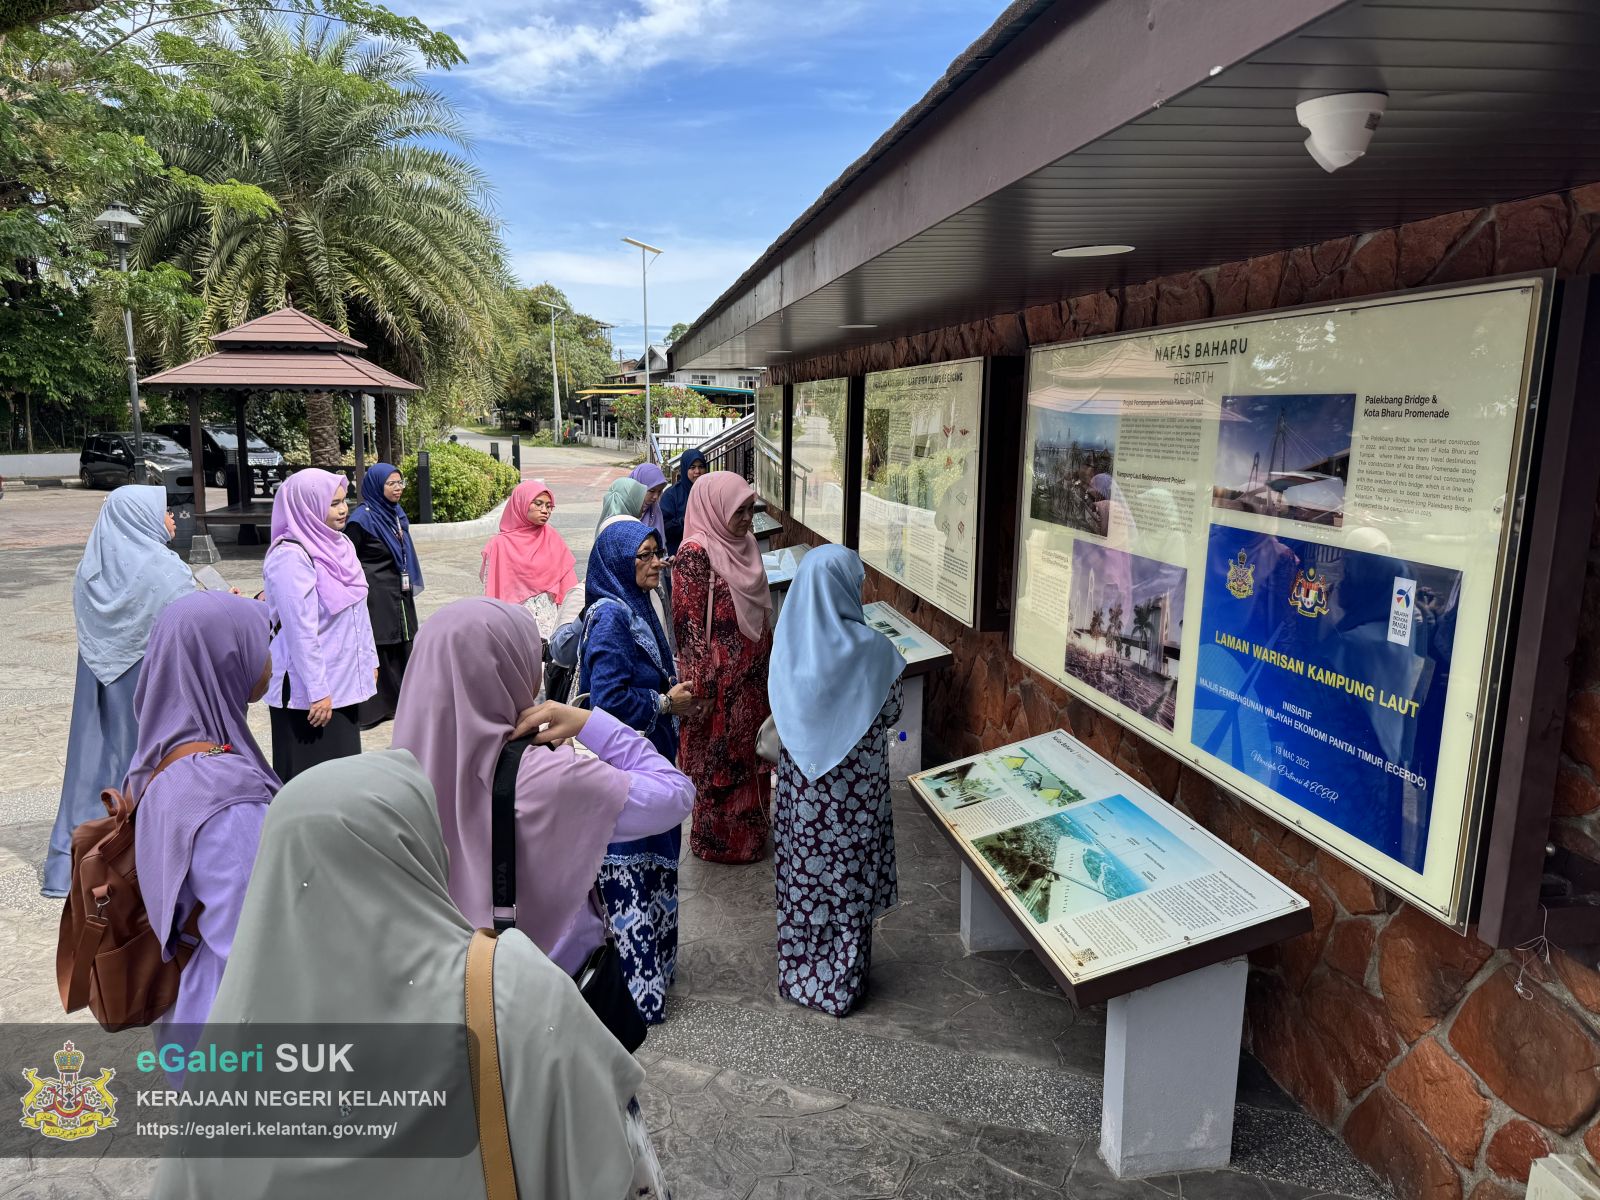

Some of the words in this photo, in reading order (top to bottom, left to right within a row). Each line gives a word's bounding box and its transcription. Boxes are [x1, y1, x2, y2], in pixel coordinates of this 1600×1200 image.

[1155, 344, 1190, 361] NAFAS
[1194, 338, 1248, 358] BAHARU
[1173, 371, 1214, 385] REBIRTH
[1365, 395, 1403, 406] Palekbang
[1404, 395, 1430, 406] Bridge
[1431, 395, 1438, 404] &
[1363, 408, 1380, 417] Kota
[1381, 408, 1403, 418] Bharu
[1404, 408, 1450, 419] Promenade
[1391, 627, 1407, 638] TIMUR
[1215, 630, 1250, 655] LAMAN
[1252, 643, 1305, 675] WARISAN
[1307, 663, 1375, 702] KAMPUNG
[1379, 689, 1420, 718] LAUT
[1282, 700, 1313, 720] INISIATIF
[1199, 677, 1219, 692] MAJLIS
[1219, 686, 1264, 714] PEMBANGUNAN
[1265, 706, 1293, 727] WILAYAH
[1294, 719, 1328, 743] EKONOMI
[1329, 735, 1356, 755] PANTAI
[1357, 747, 1384, 769] TIMUR
[1385, 760, 1427, 791] (ECERDC)
[1275, 745, 1282, 755] 19
[1283, 749, 1295, 762] MAC
[1295, 755, 1310, 770] 2022
[1309, 781, 1339, 804] ECER
